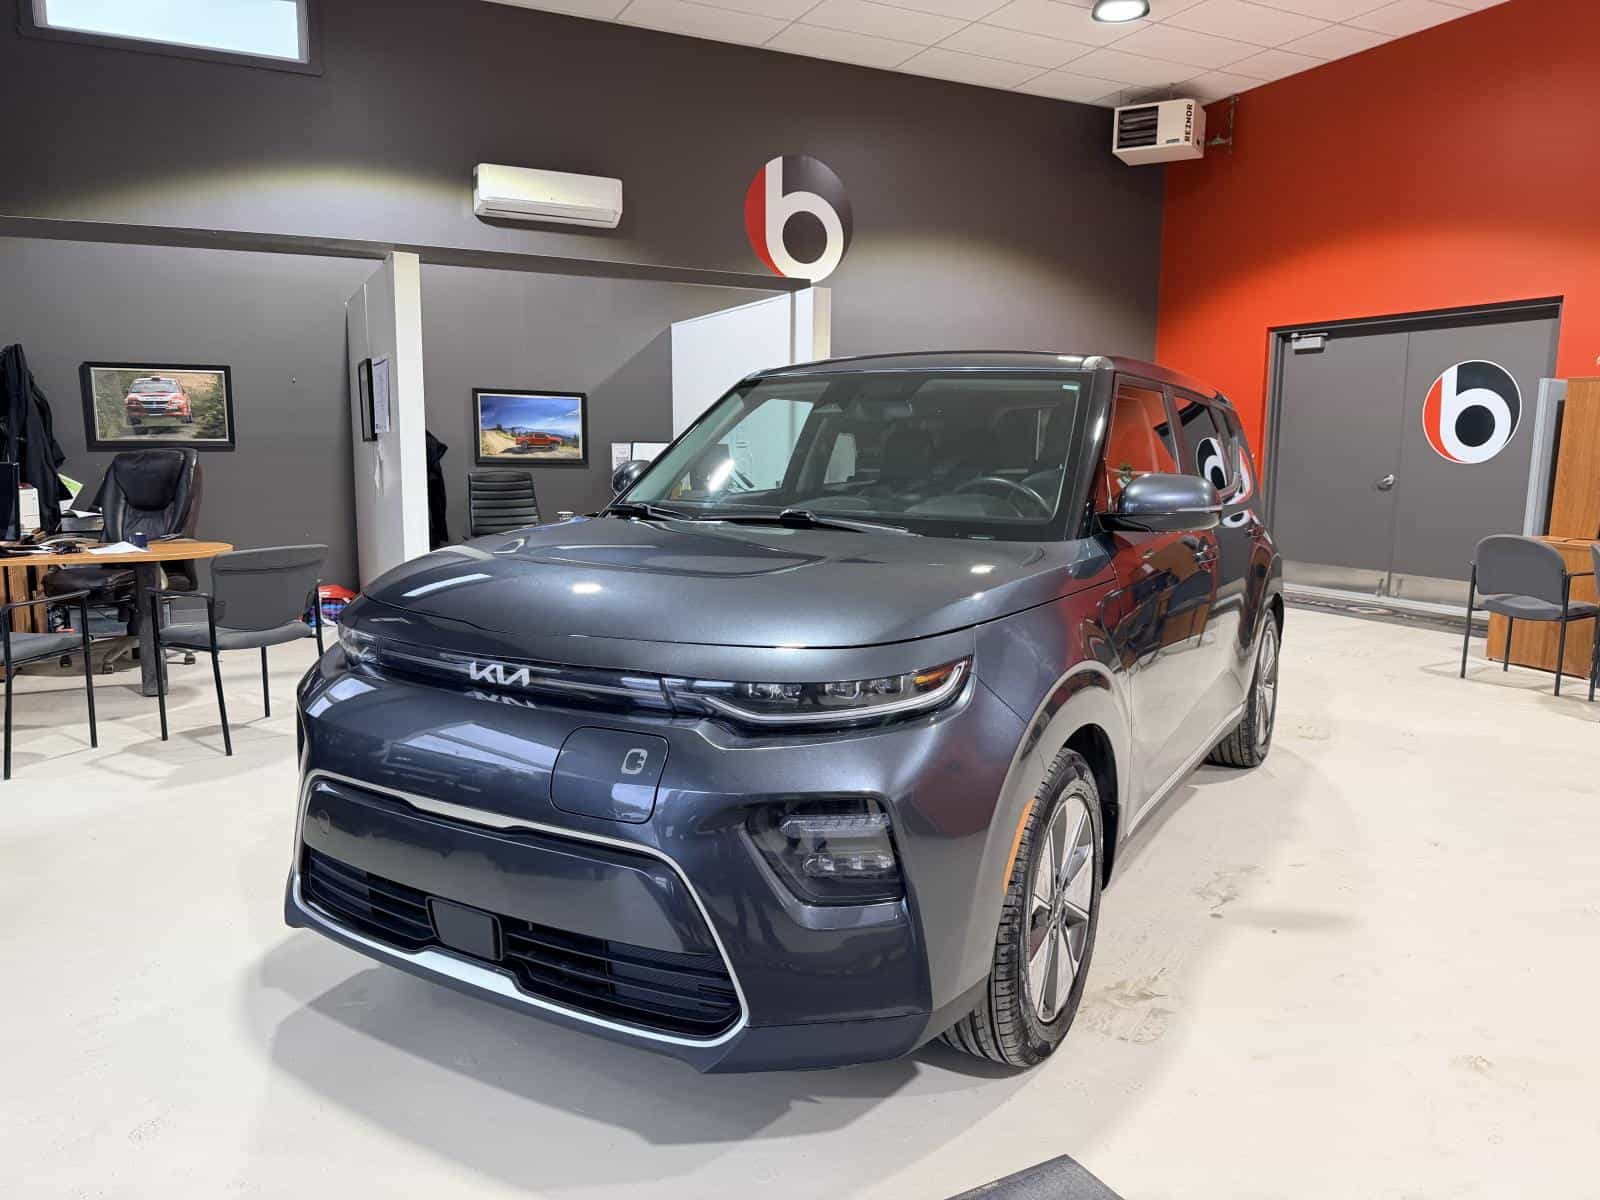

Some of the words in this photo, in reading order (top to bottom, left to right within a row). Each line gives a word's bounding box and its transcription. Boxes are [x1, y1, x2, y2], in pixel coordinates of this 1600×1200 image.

[1184, 103, 1193, 142] REZNOR
[765, 156, 844, 283] b
[1440, 363, 1512, 463] b
[469, 661, 530, 687] KIA
